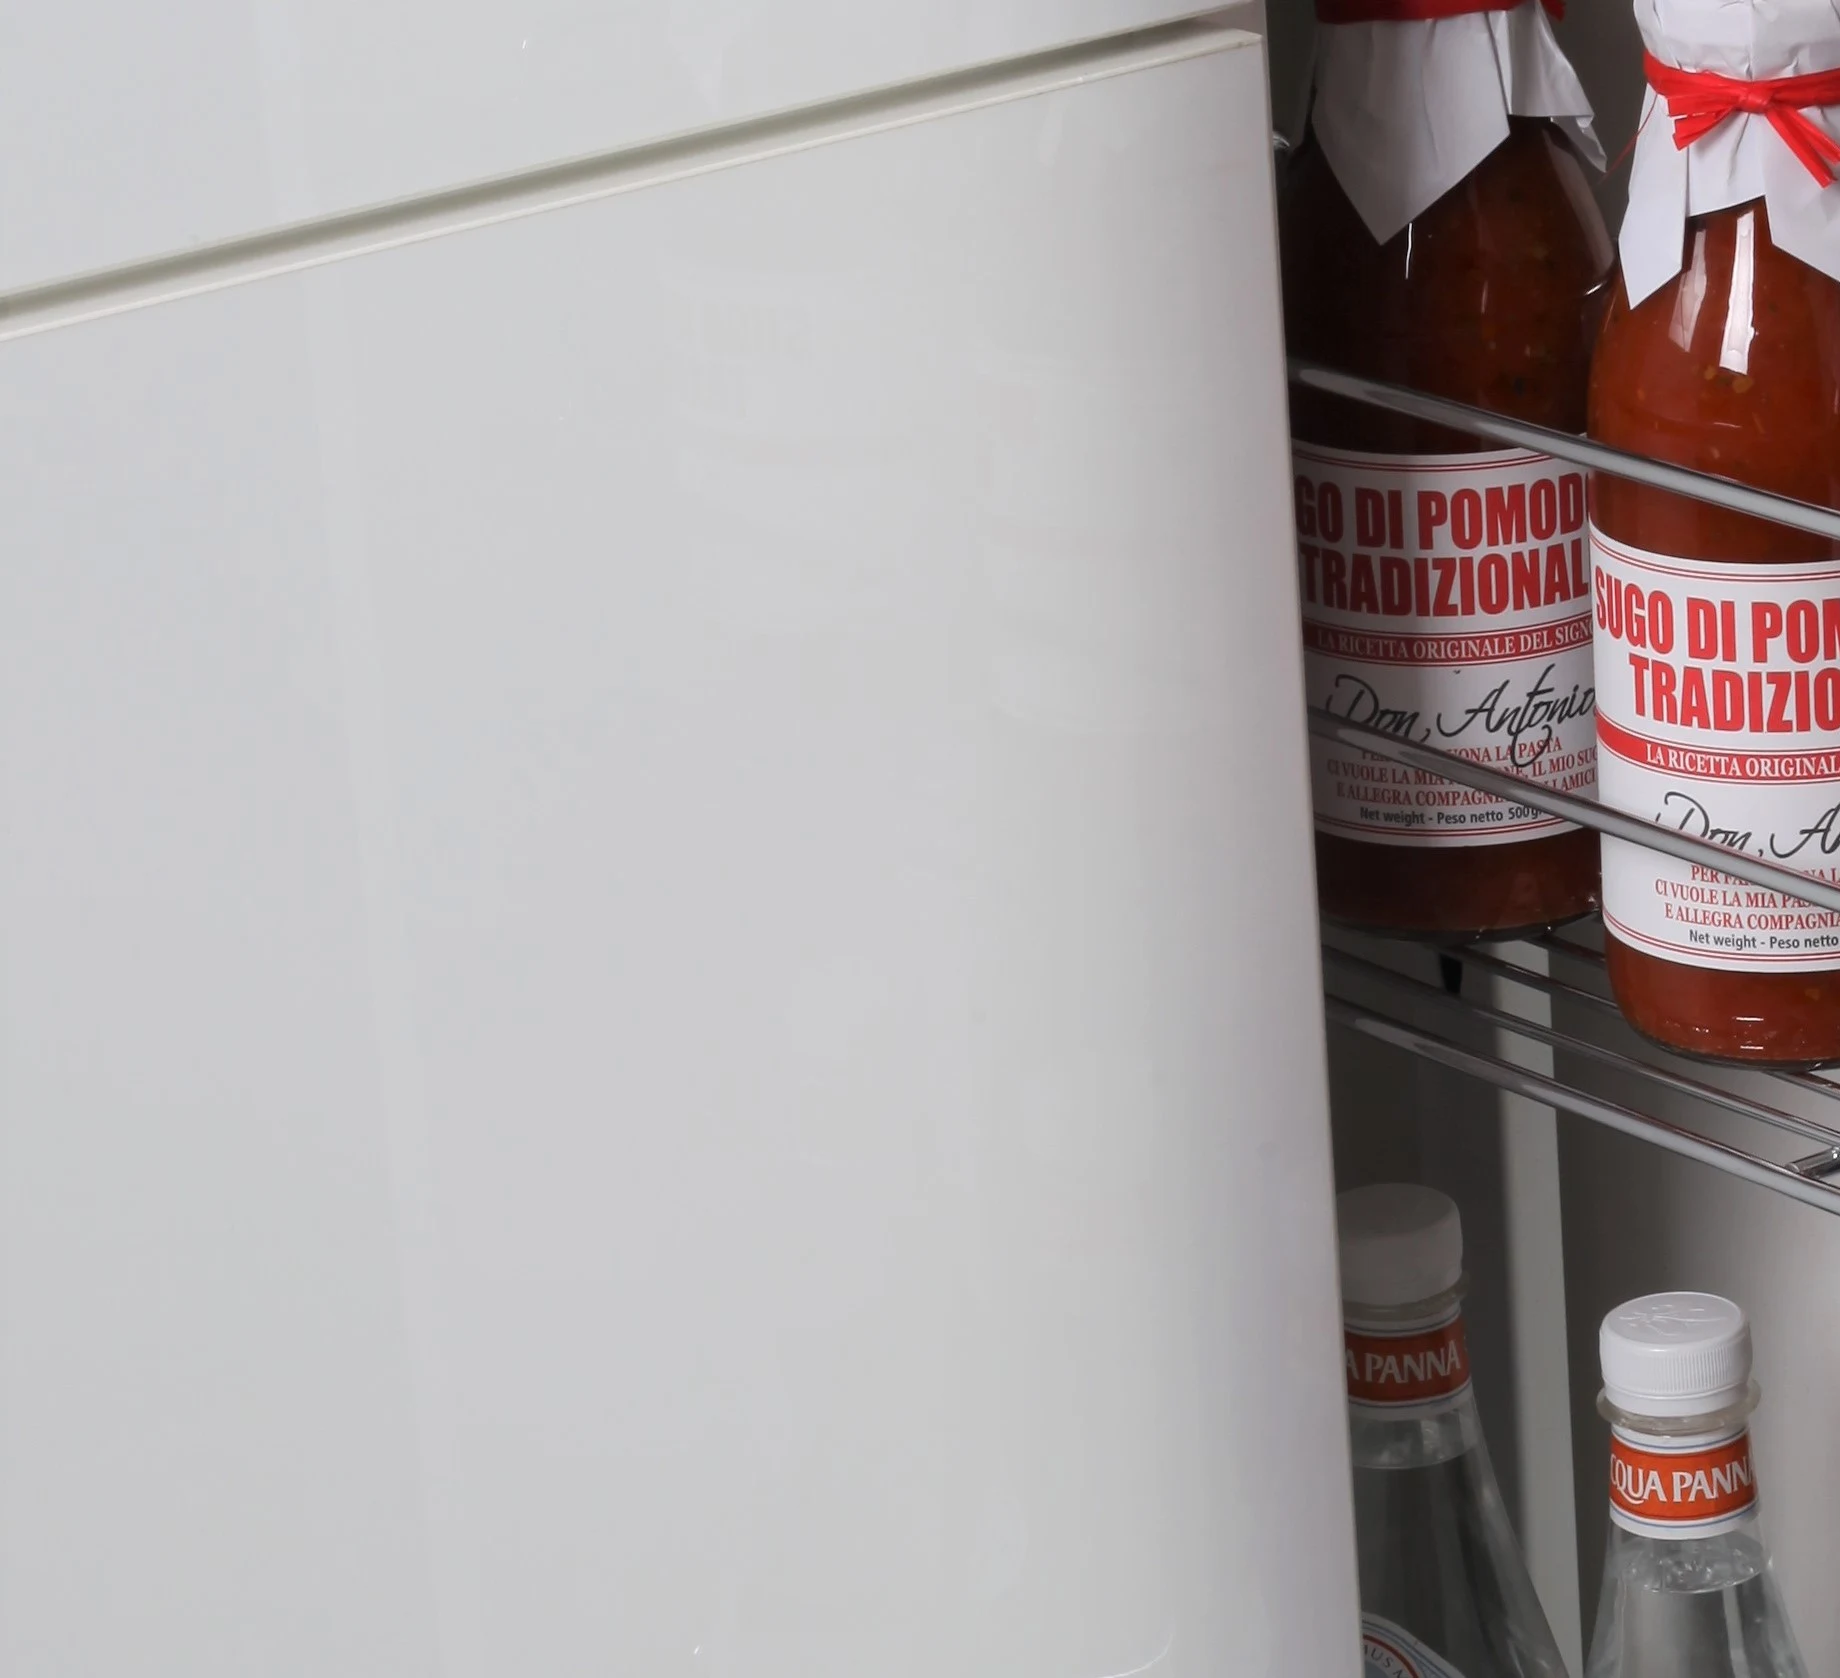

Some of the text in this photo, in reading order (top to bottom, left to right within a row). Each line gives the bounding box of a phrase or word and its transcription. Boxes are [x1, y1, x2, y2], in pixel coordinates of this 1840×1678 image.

[1294, 471, 1588, 550] GO DI POMOD
[1300, 538, 1589, 617] TRADIZIONAL
[1595, 565, 1674, 655] SUGO
[1686, 595, 1737, 663] DI
[1317, 621, 1594, 659] LA RICETTA ORIGINALE DEL SIGN
[1518, 736, 1562, 758] PASTA
[1532, 761, 1547, 778] IL
[1549, 754, 1576, 774] MIO
[1577, 745, 1597, 767] SUG
[1646, 743, 1665, 765] LA
[1667, 746, 1742, 778] RICETTA
[1341, 761, 1389, 783] VUOLE
[1391, 767, 1411, 785] LA
[1337, 782, 1345, 798] E
[1346, 784, 1413, 806] ALLEGRA
[1359, 806, 1380, 820] Net
[1383, 807, 1426, 827] weight
[1437, 811, 1467, 825] Peso
[1470, 810, 1504, 824] netto
[1691, 864, 1721, 885] PER
[1655, 878, 1667, 896] CI
[1669, 882, 1719, 905] VUOLE
[1722, 890, 1742, 908] LA
[1745, 891, 1778, 909] MIA
[1664, 902, 1673, 919] E
[1676, 905, 1743, 929] ALLEGRA
[1689, 929, 1710, 945] Net
[1713, 930, 1757, 951] weight
[1769, 935, 1801, 950] Peso
[1804, 934, 1839, 949] netto
[1364, 1339, 1462, 1384] PANNA
[1610, 1453, 1754, 1505] CQUA PANN
